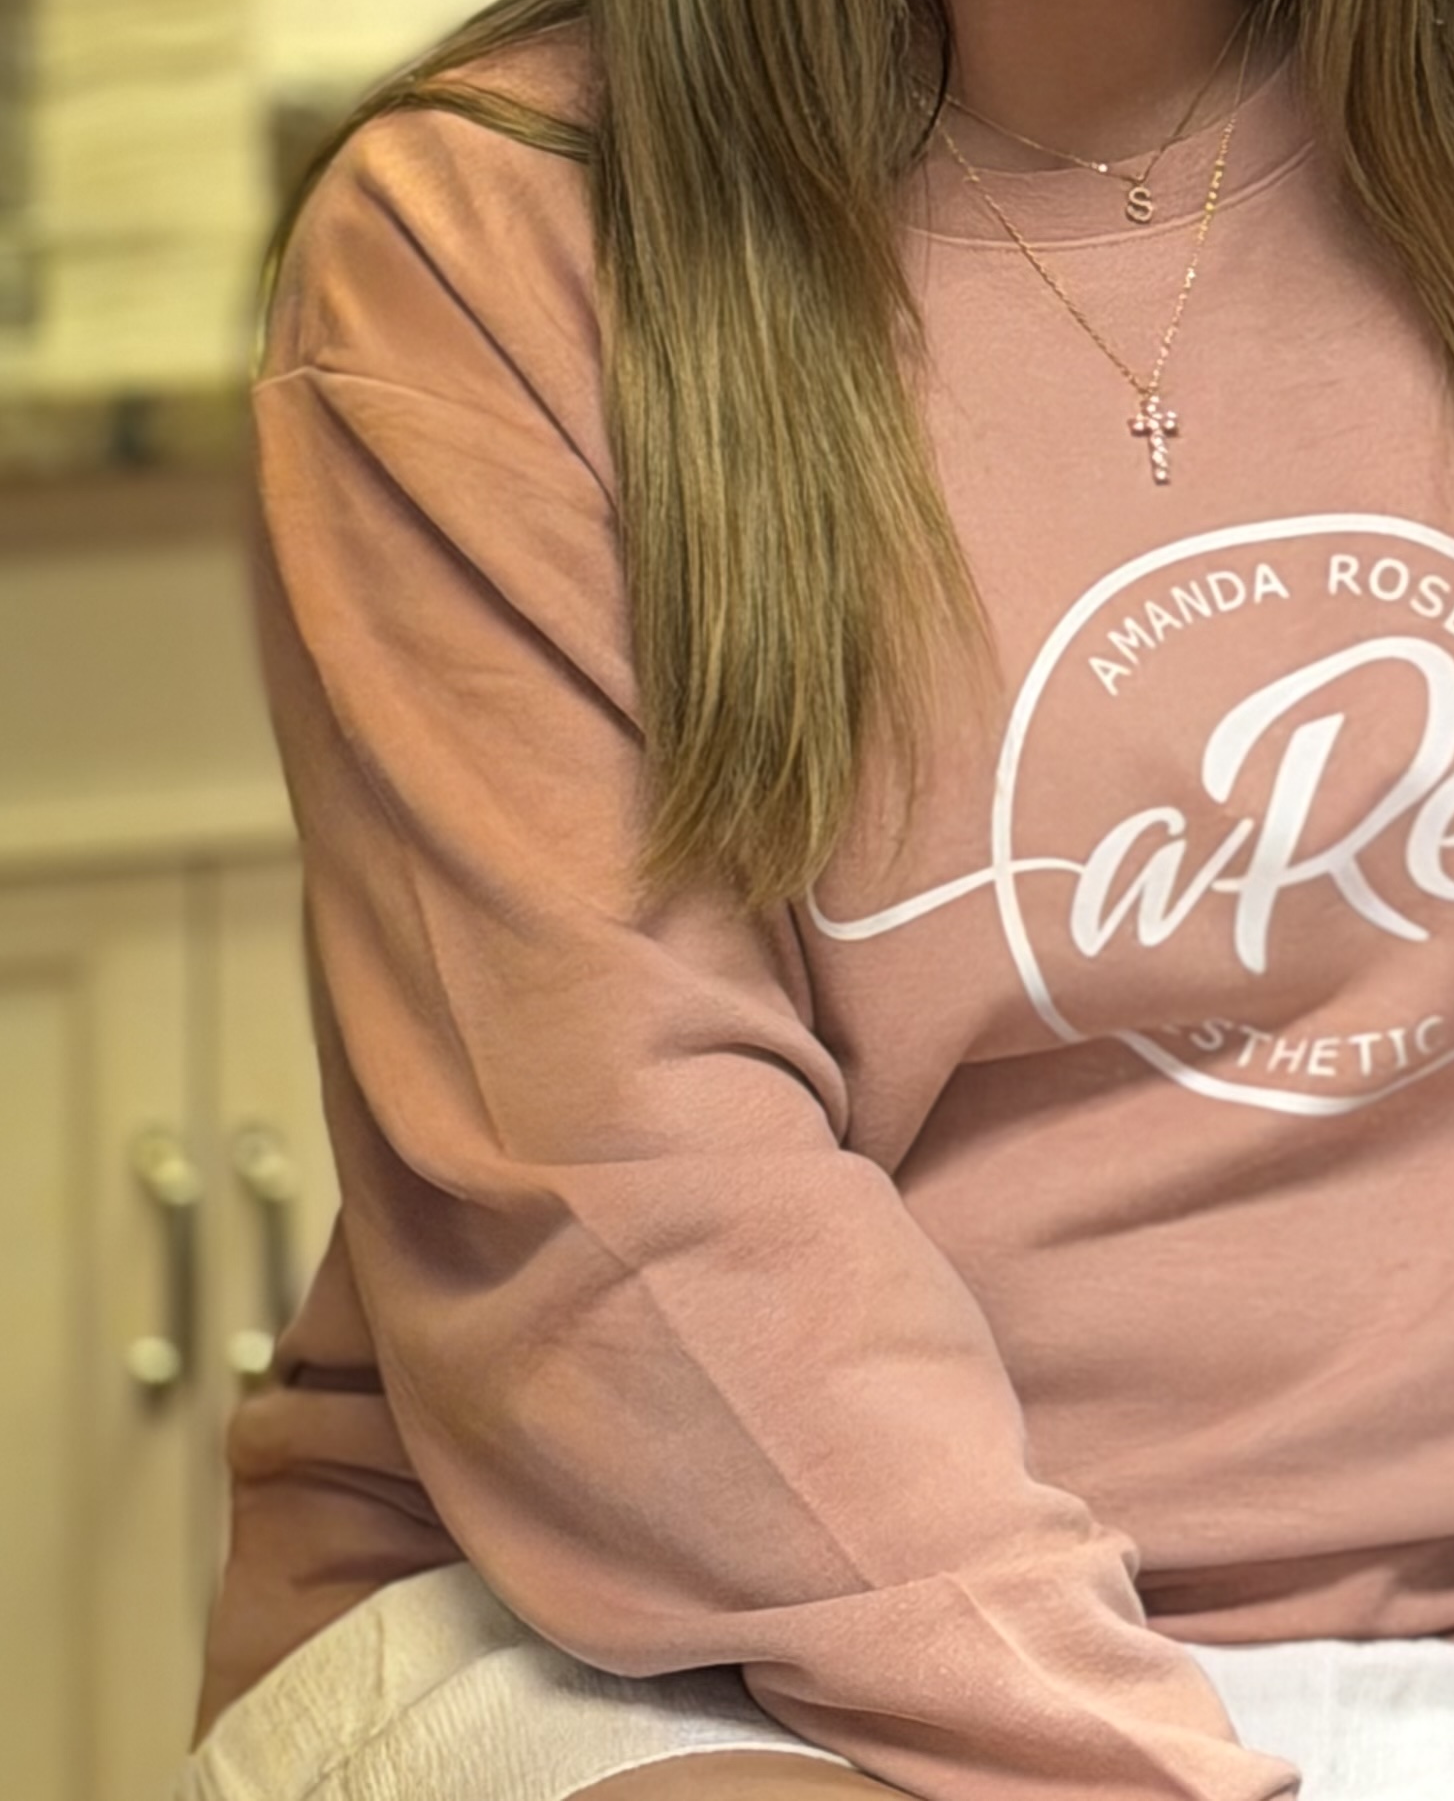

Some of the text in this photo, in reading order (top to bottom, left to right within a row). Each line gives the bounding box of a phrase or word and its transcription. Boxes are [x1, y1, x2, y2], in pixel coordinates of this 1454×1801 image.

[1127, 186, 1153, 223] S
[1088, 562, 1290, 696] AMANDA
[1162, 1014, 1445, 1077] STHETIC
